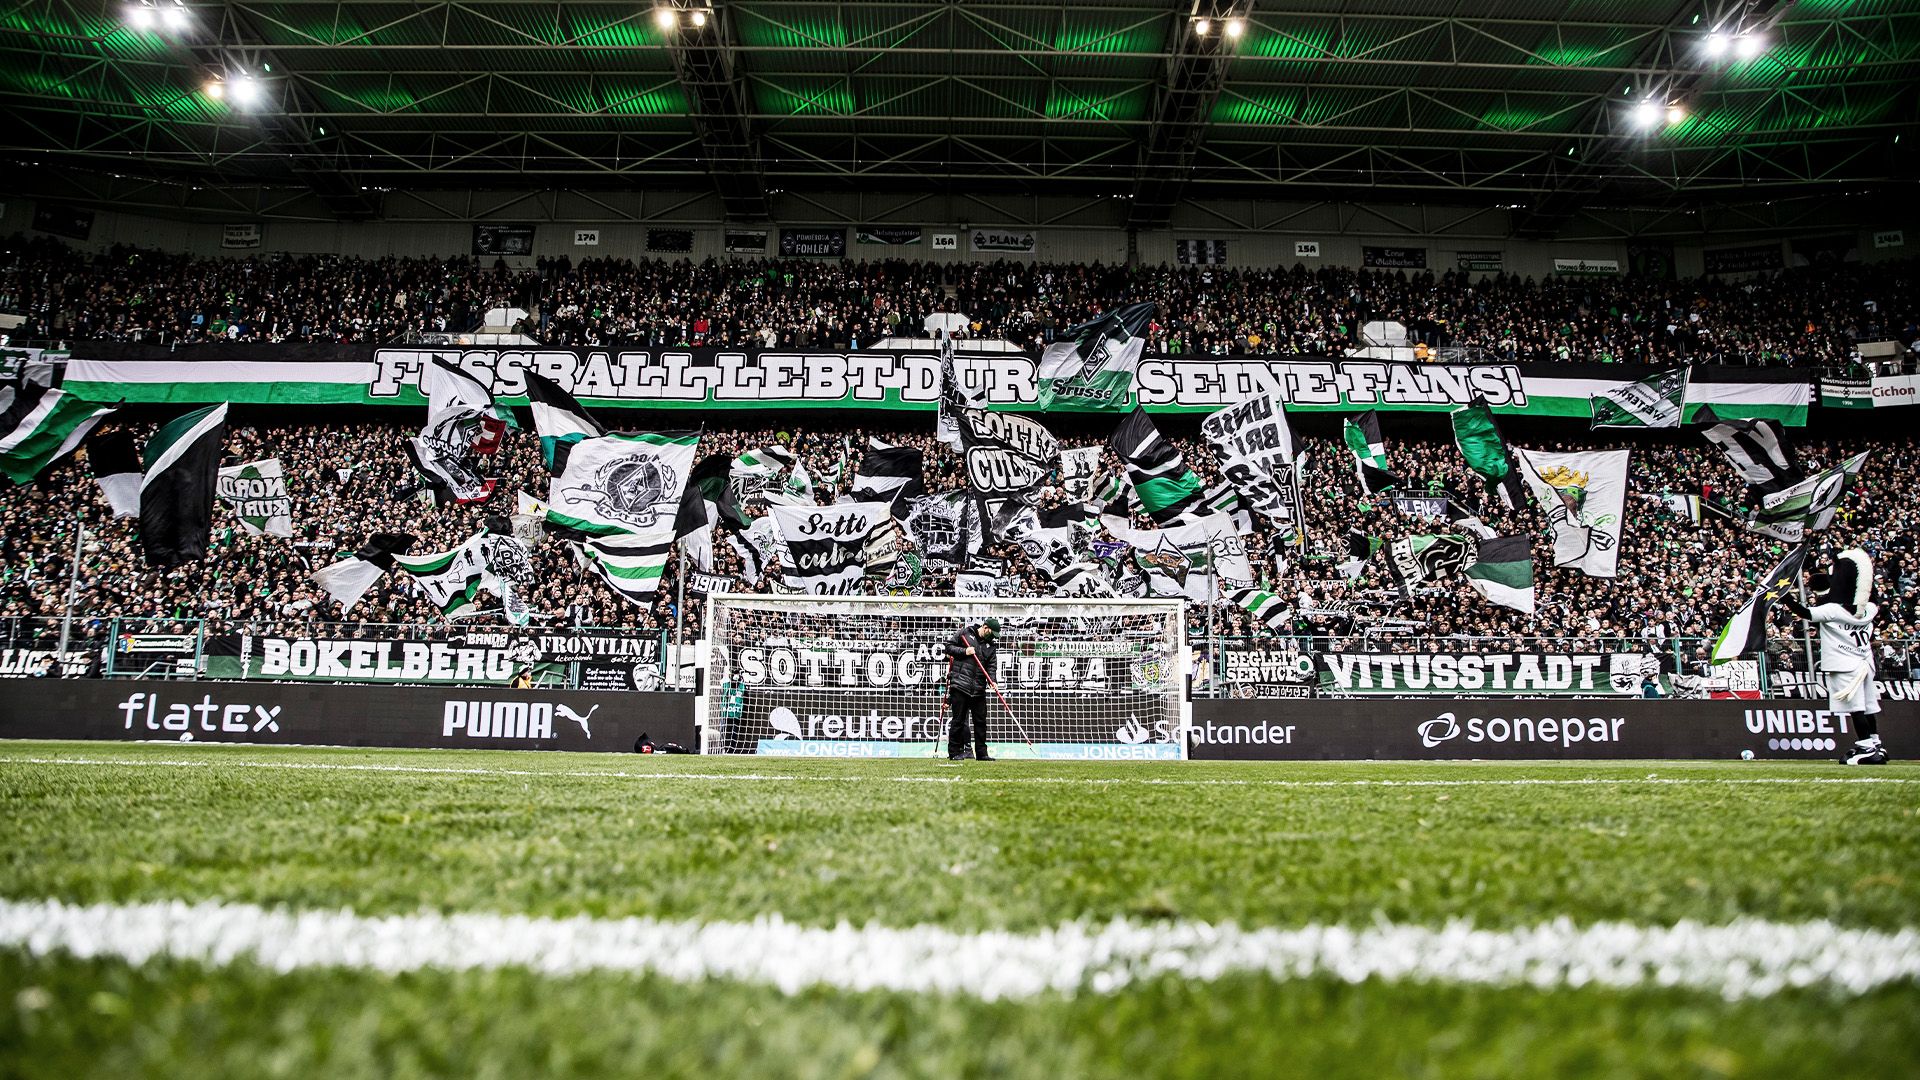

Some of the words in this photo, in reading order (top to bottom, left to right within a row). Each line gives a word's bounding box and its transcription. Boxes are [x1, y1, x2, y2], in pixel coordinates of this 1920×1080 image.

[576, 233, 597, 243] 17A
[935, 238, 955, 246] 16A
[795, 243, 830, 254] FOHLEN
[1297, 245, 1317, 253] 15A
[369, 348, 707, 401] FUSSBALL
[714, 353, 895, 402] LEBT
[1136, 359, 1340, 406] SEINE
[1340, 362, 1529, 408] FANS!
[1872, 386, 1916, 398] Cichon
[799, 512, 867, 538] Sotto
[921, 558, 949, 568] RUSSIA
[692, 574, 731, 593] 1900
[539, 635, 659, 658] FRONTLINE
[1850, 630, 1870, 648] 10
[261, 637, 513, 680] BÖKELBERG
[610, 655, 628, 663] seit
[738, 645, 1110, 688] SOTTOCUTURA
[1225, 650, 1299, 667] BEGLEIT
[1226, 666, 1299, 683] SERVICE
[1324, 654, 1601, 690] VITUSSTADT
[118, 692, 282, 733] flatex
[443, 701, 553, 739] PUMA
[1745, 709, 1852, 734] UNIBET
[808, 710, 951, 739] reuter.c
[1467, 716, 1625, 748] sonepar
[795, 743, 873, 756] JONGEN
[1080, 745, 1157, 759] JONGEN
